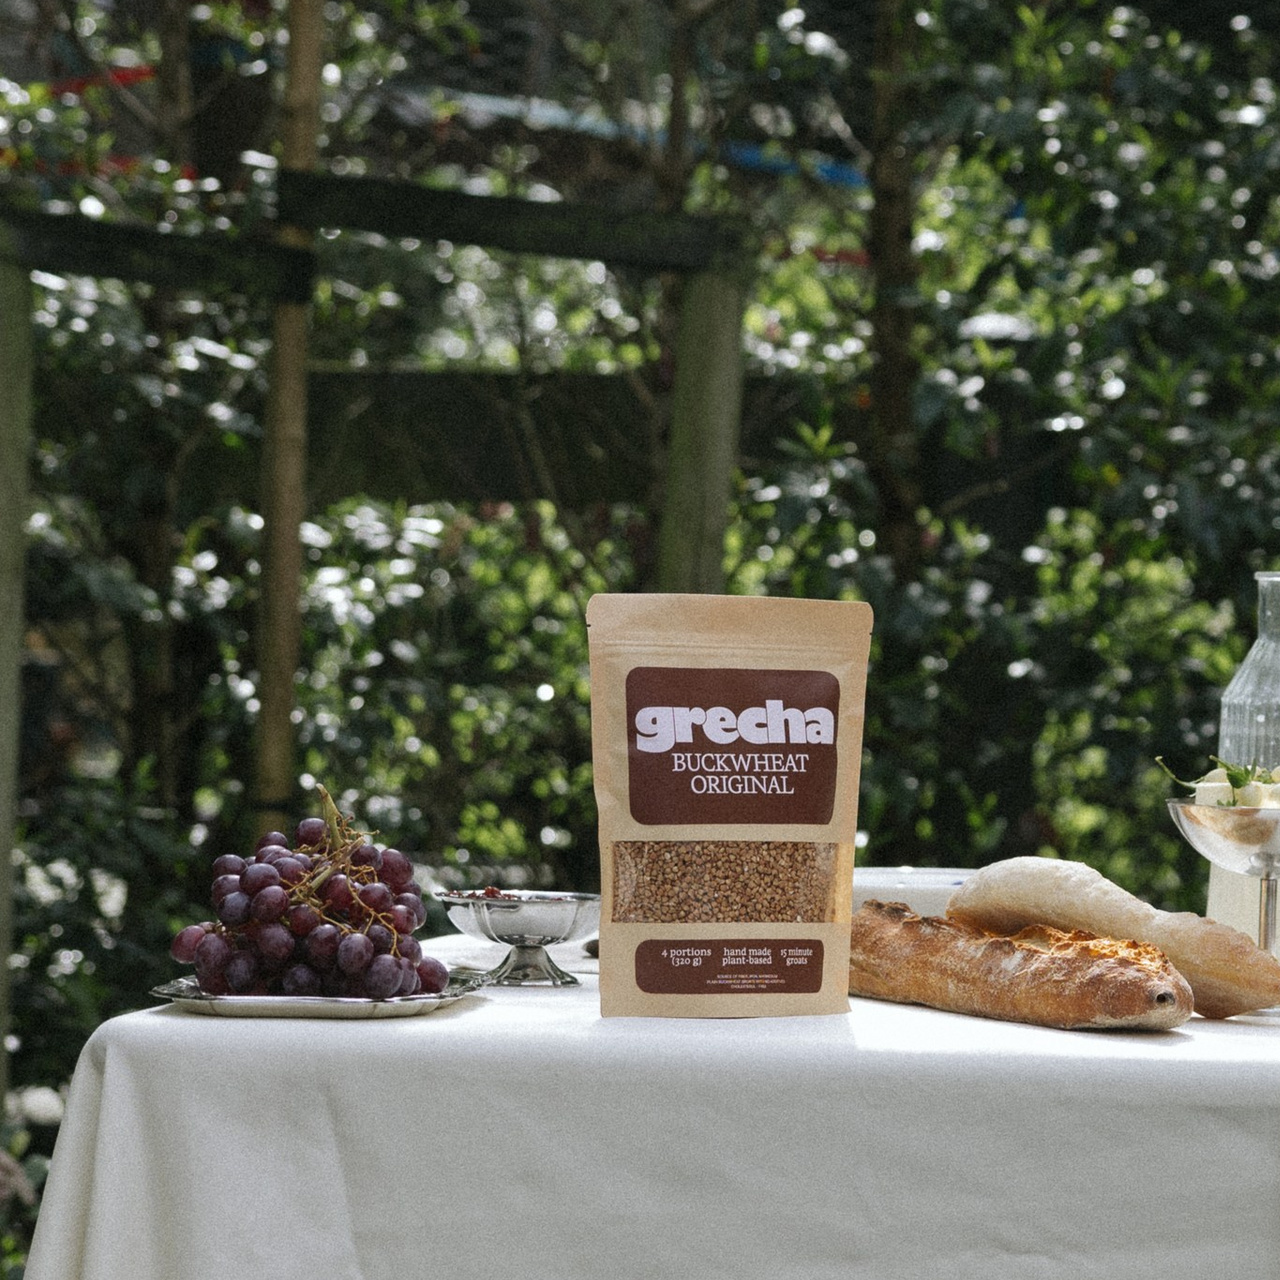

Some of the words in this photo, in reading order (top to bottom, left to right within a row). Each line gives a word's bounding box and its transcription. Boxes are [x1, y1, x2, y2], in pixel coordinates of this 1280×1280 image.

[635, 699, 834, 753] grecha
[671, 753, 810, 773] BUCKWHEAT
[690, 775, 795, 795] ORIGINAL
[661, 948, 668, 958] 4
[670, 947, 712, 958] portions
[723, 947, 747, 956] hand
[748, 947, 772, 956] made
[780, 948, 787, 958] 15
[788, 947, 813, 956] minute
[671, 956, 691, 967] (320
[692, 956, 702, 967] g)
[722, 956, 772, 967] plant-based
[786, 956, 808, 967] groats
